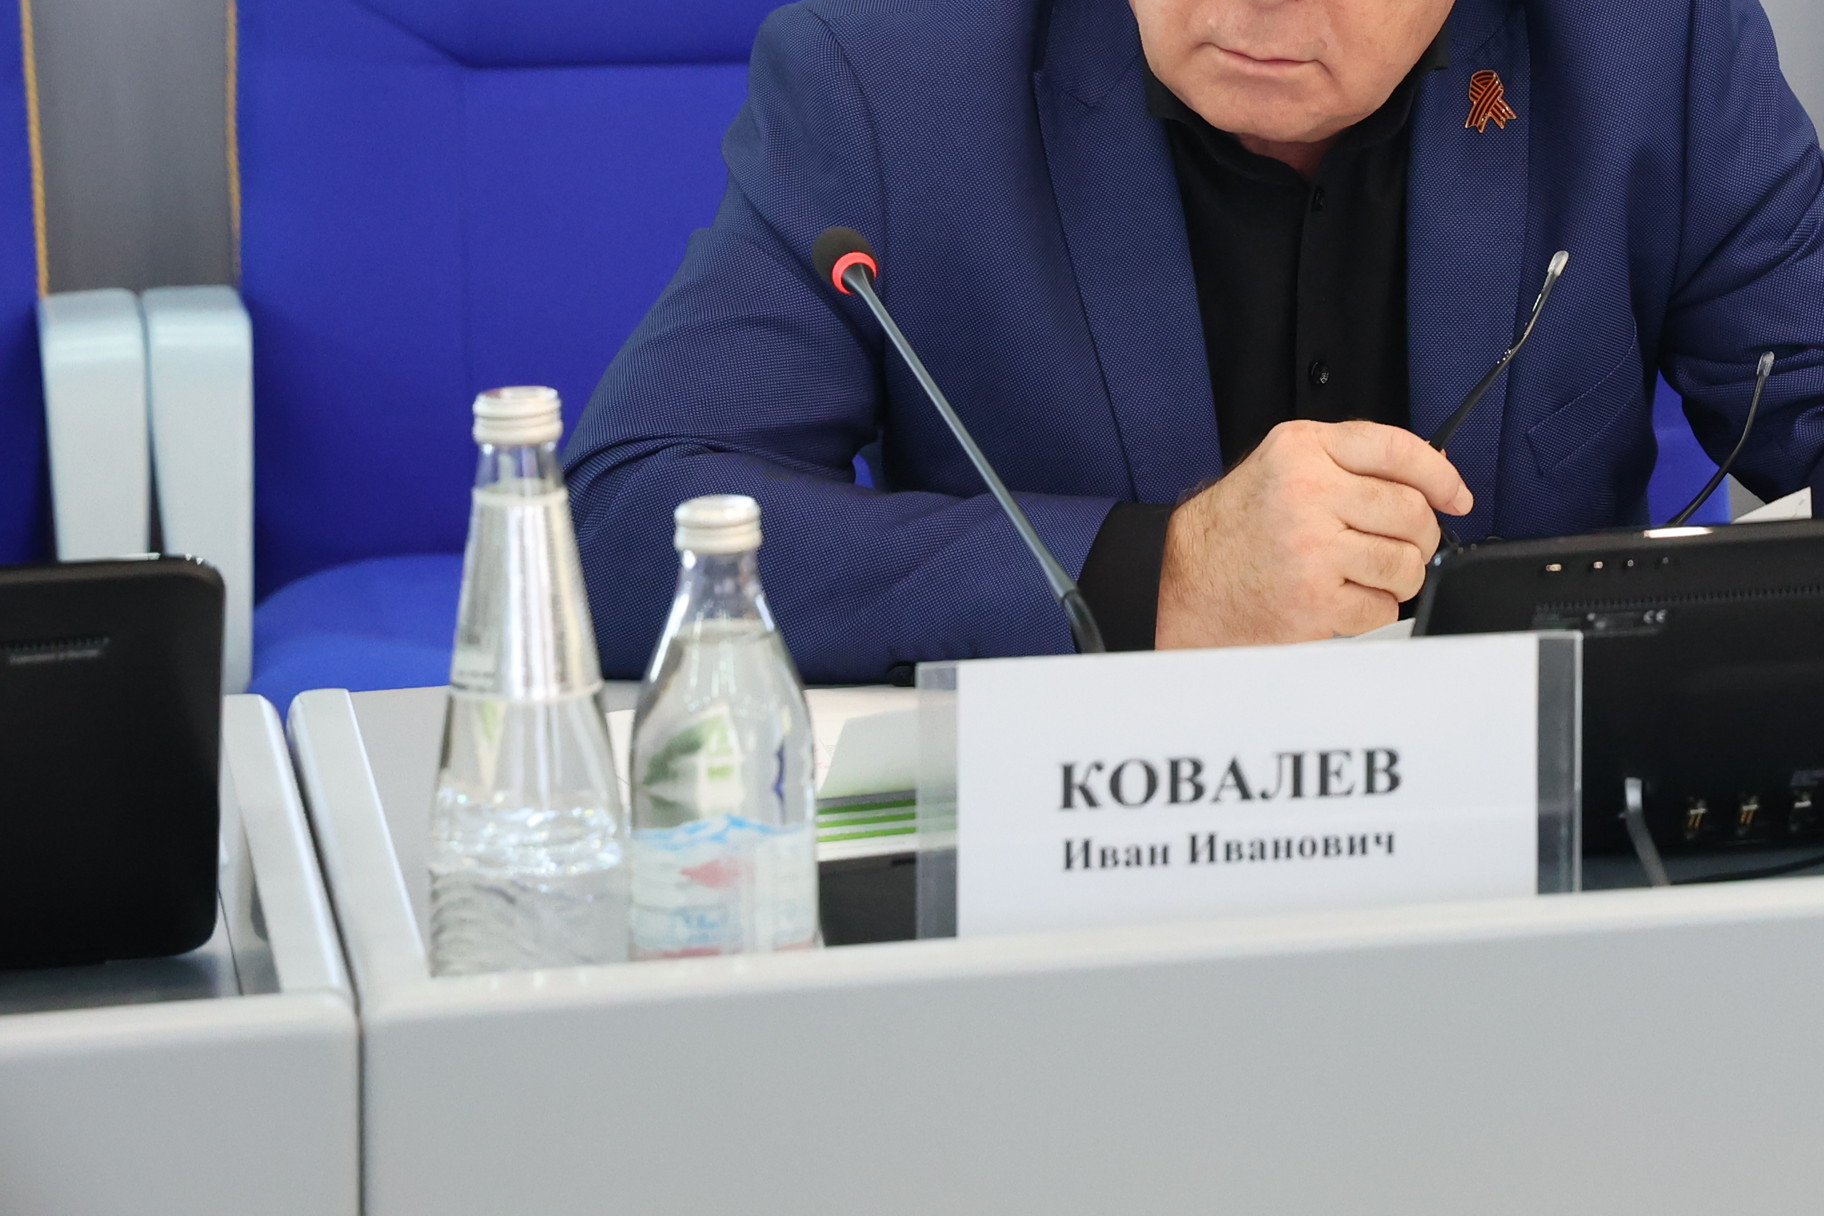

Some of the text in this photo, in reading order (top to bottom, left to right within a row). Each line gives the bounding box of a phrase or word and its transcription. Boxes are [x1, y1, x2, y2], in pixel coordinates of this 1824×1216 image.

[1057, 746, 1403, 812] КОВАЛЕВ
[1062, 830, 1395, 872] Иван Иванович
